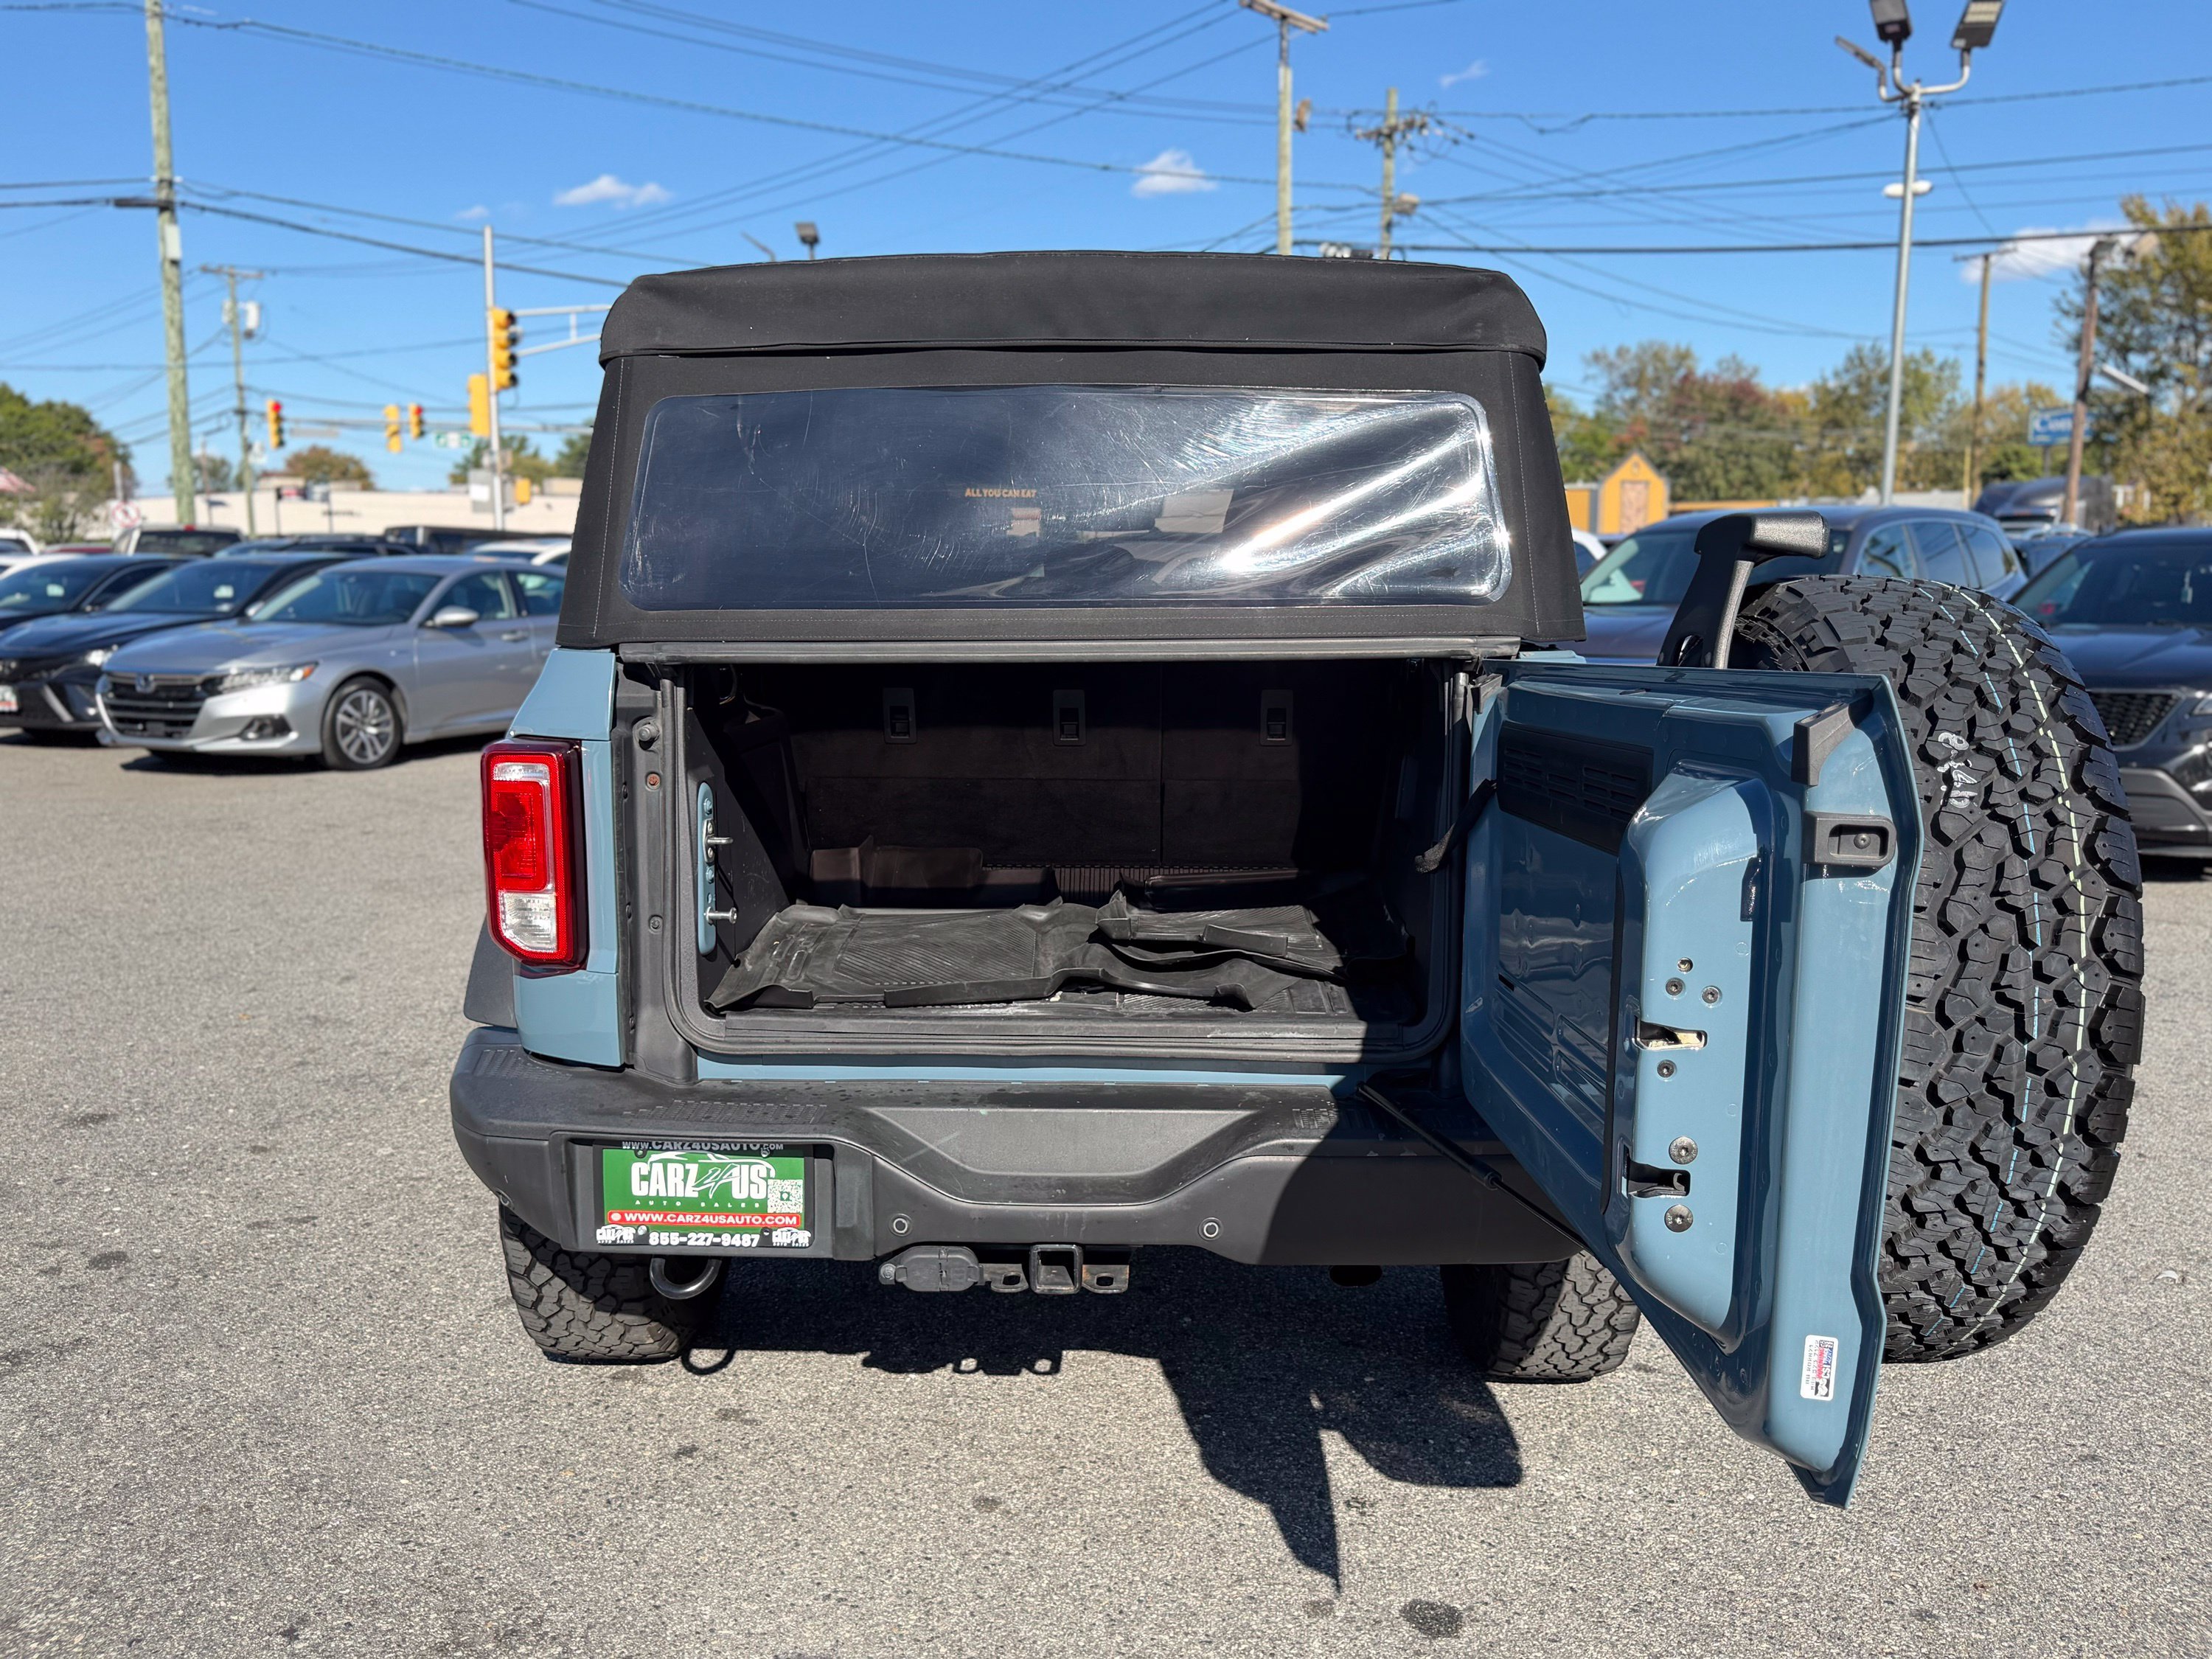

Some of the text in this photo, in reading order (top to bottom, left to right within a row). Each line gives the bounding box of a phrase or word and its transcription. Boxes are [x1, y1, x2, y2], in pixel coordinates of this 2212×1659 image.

[964, 488, 1037, 498] ALL YOU CAN EAT
[624, 1212, 797, 1225] WWW.CARZ4USAUTO.COM
[649, 1231, 760, 1247] 855-227-9487
